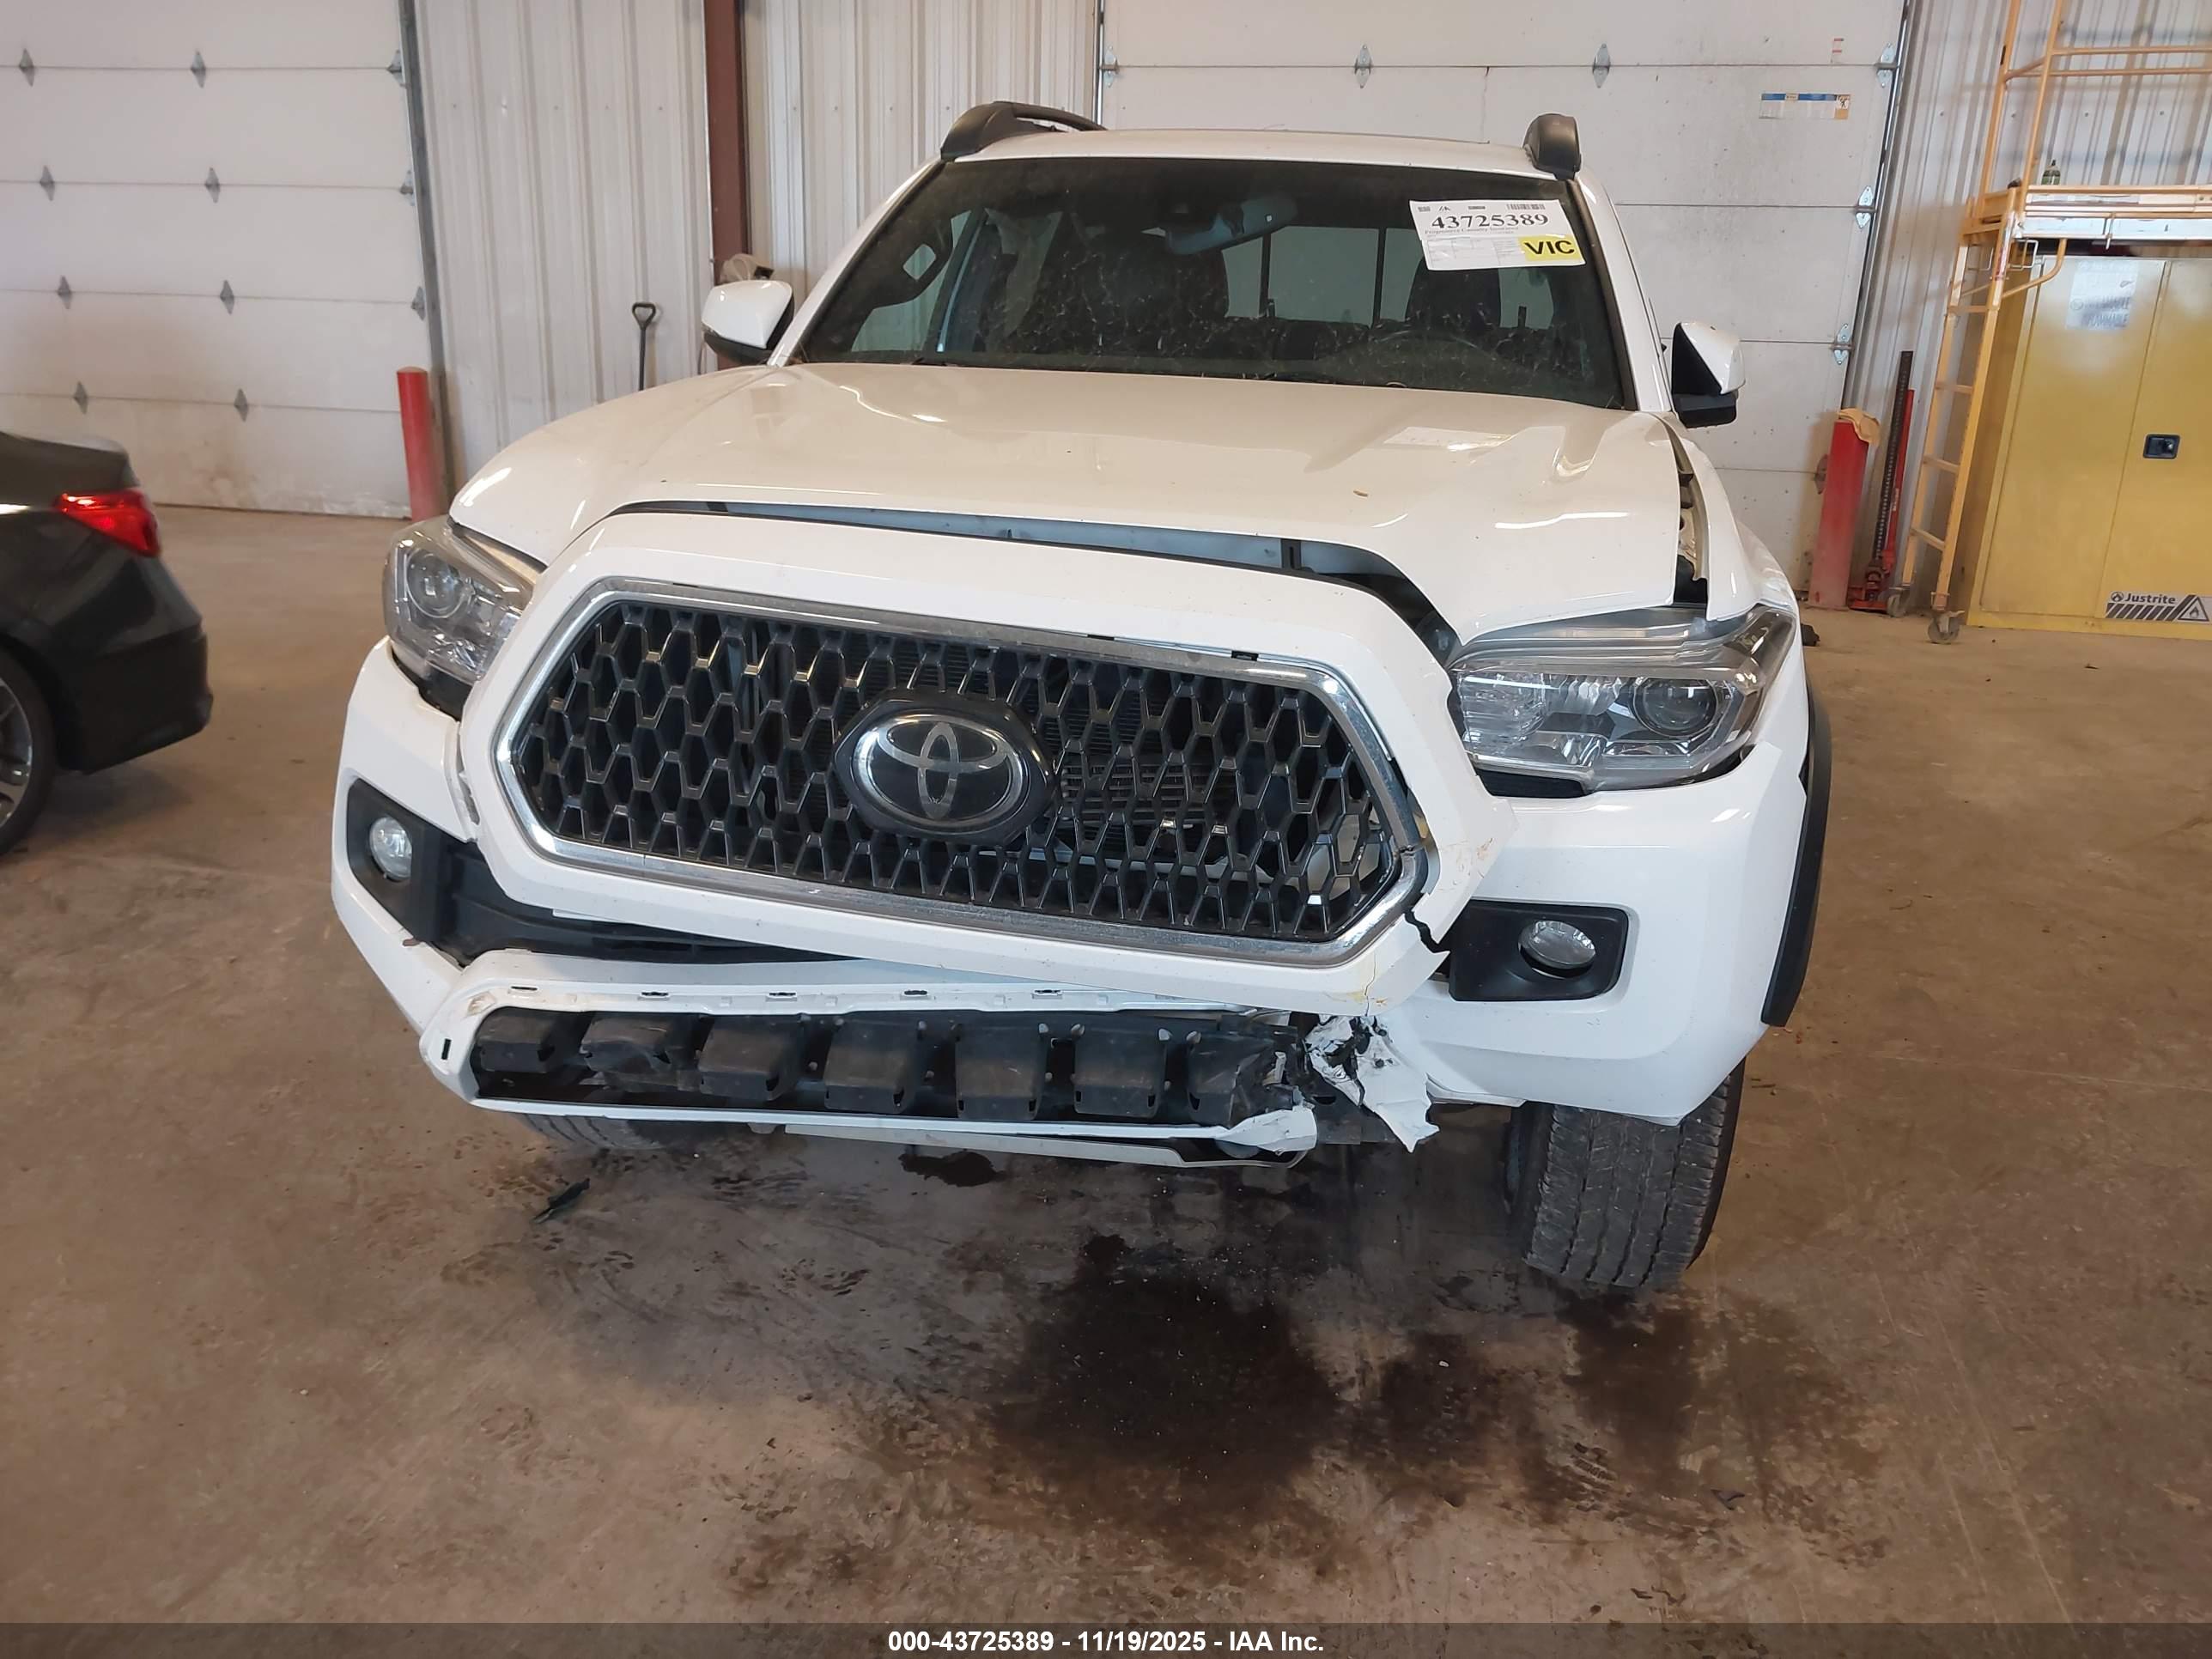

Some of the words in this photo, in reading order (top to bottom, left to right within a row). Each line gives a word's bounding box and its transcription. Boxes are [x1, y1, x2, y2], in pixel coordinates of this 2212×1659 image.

[1431, 213, 1549, 228] 43725389
[1524, 240, 1575, 255] VIC
[2125, 592, 2176, 605] Justrite
